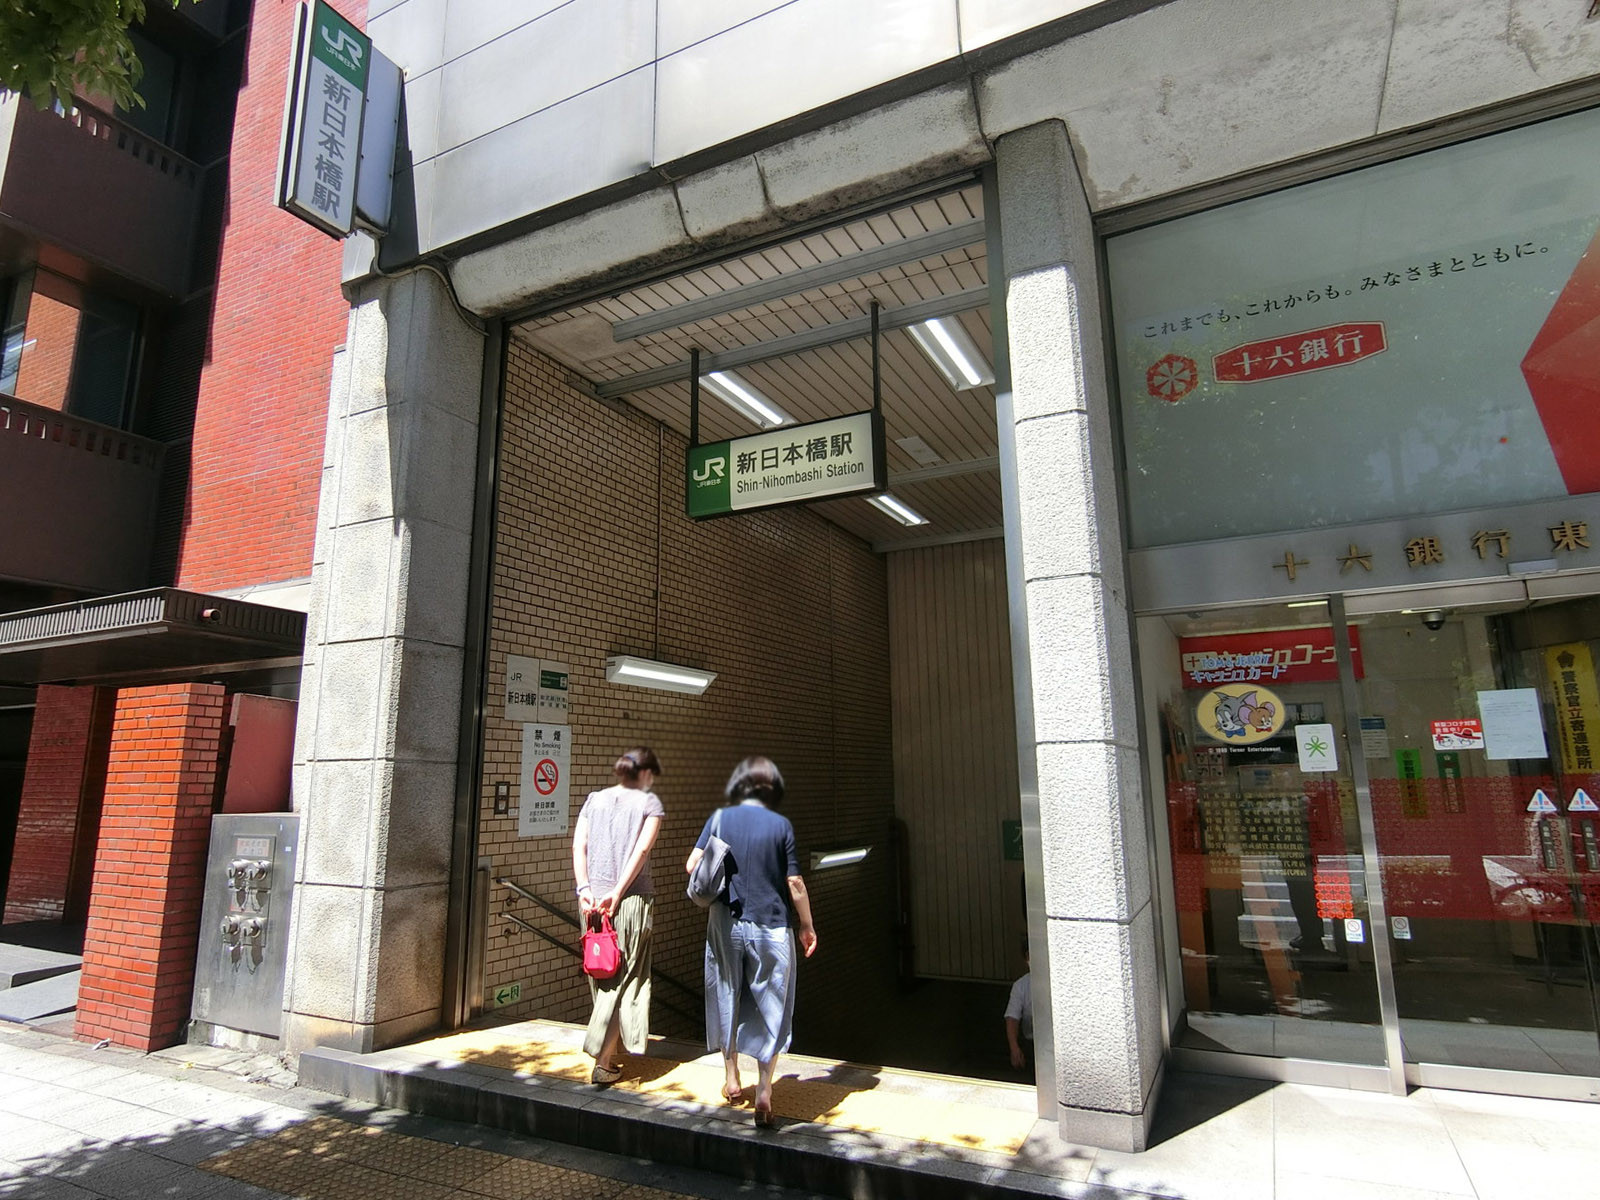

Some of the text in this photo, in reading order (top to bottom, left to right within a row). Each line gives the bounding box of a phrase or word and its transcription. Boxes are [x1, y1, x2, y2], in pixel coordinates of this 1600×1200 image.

[321, 25, 364, 68] JR
[311, 73, 352, 219] 新日本橋駅
[1232, 329, 1364, 377] 十六銀行
[737, 432, 853, 475] 新日本橋駅
[693, 457, 725, 482] JR
[736, 461, 865, 494] Shin-Nihombashi Station
[511, 672, 522, 682] JR
[1189, 665, 1288, 684] キャッシュカード
[507, 691, 537, 707] 新日本橋駅
[535, 729, 561, 741] 禁煙
[542, 742, 561, 750] Smoking
